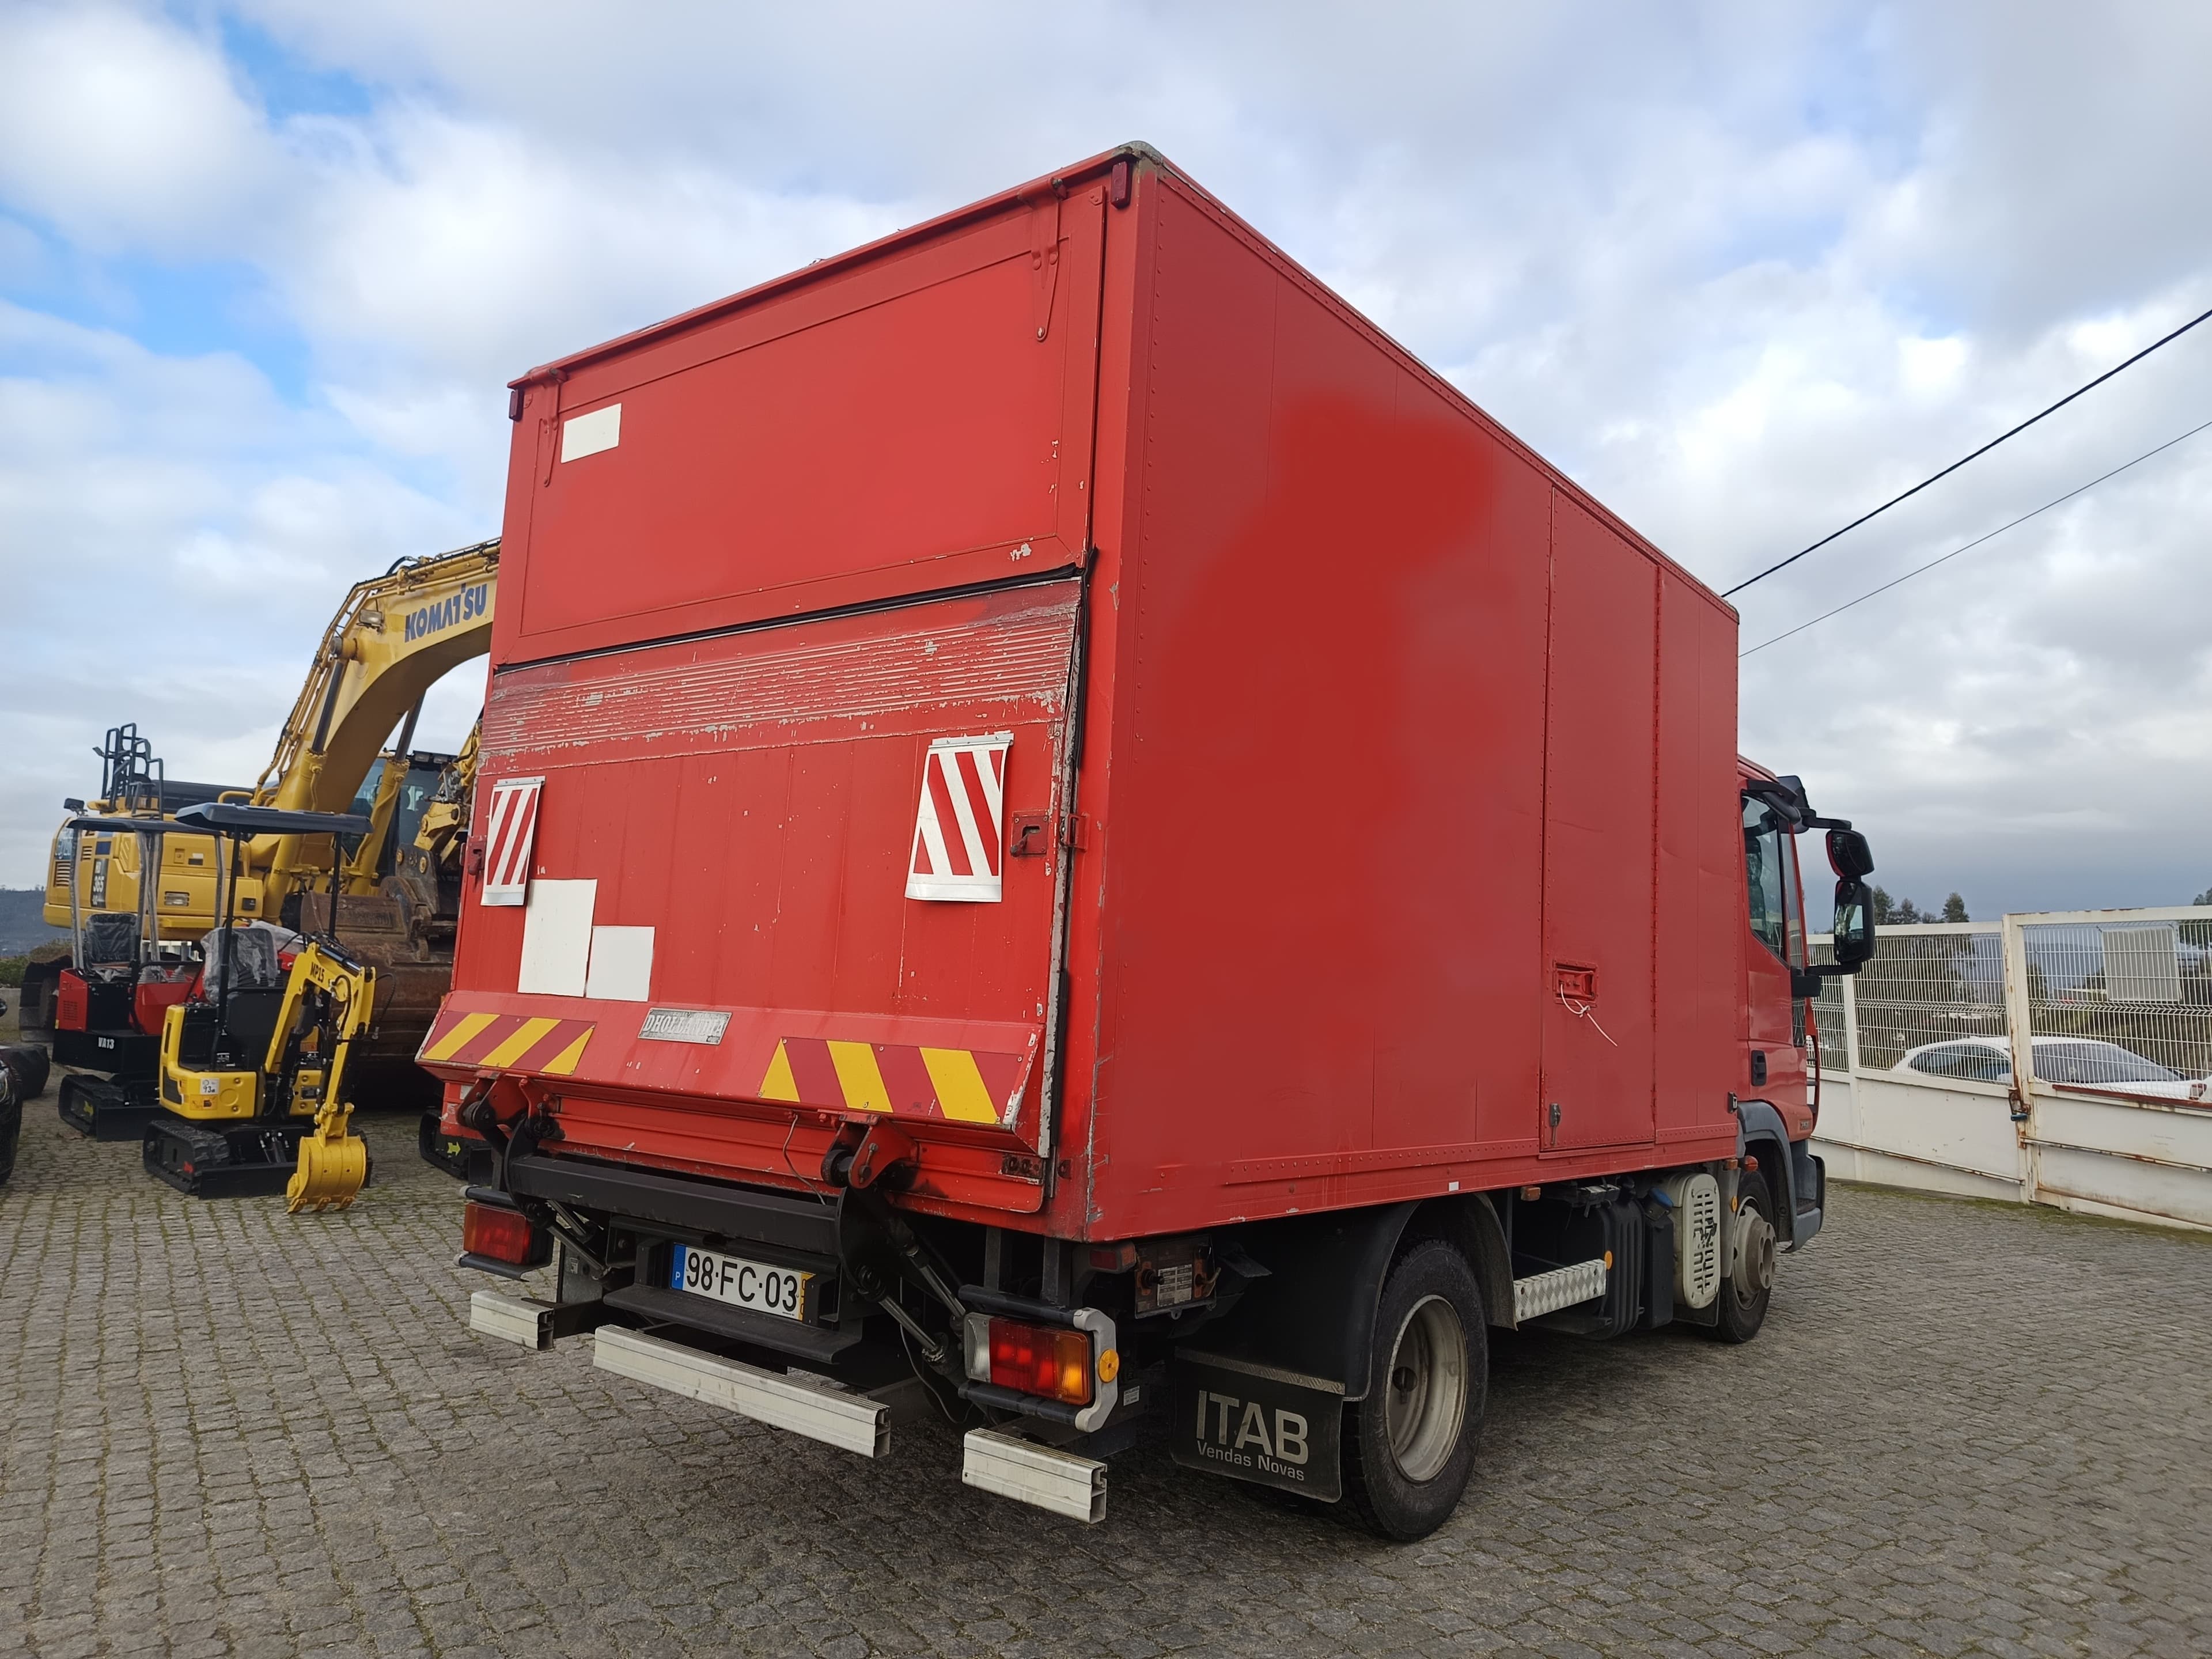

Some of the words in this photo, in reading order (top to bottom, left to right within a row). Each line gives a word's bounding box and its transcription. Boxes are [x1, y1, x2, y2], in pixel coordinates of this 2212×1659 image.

[405, 582, 487, 643] KOMATSU
[675, 1271, 681, 1281] P
[1196, 1389, 1309, 1465] ITAB
[1197, 1440, 1252, 1467] Vendas
[1258, 1455, 1305, 1482] Novas
